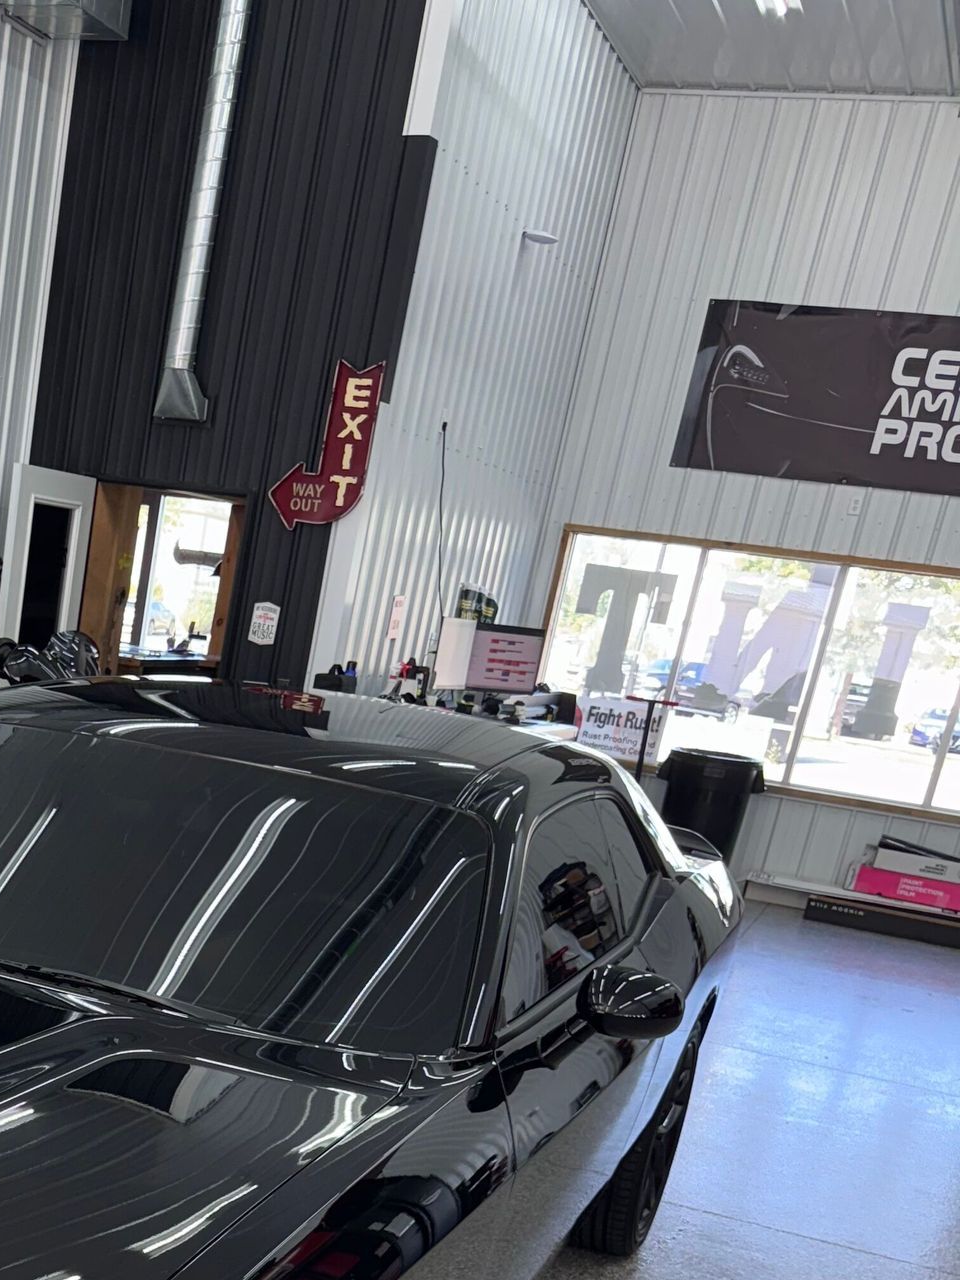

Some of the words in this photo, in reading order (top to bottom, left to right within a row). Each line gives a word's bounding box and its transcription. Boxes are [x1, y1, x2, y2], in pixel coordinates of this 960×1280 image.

[330, 377, 373, 507] EXIT
[292, 482, 325, 498] WAY
[290, 498, 322, 512] OUT
[586, 706, 623, 729] Fight
[582, 730, 602, 740] Rust
[603, 734, 638, 747] Proofing
